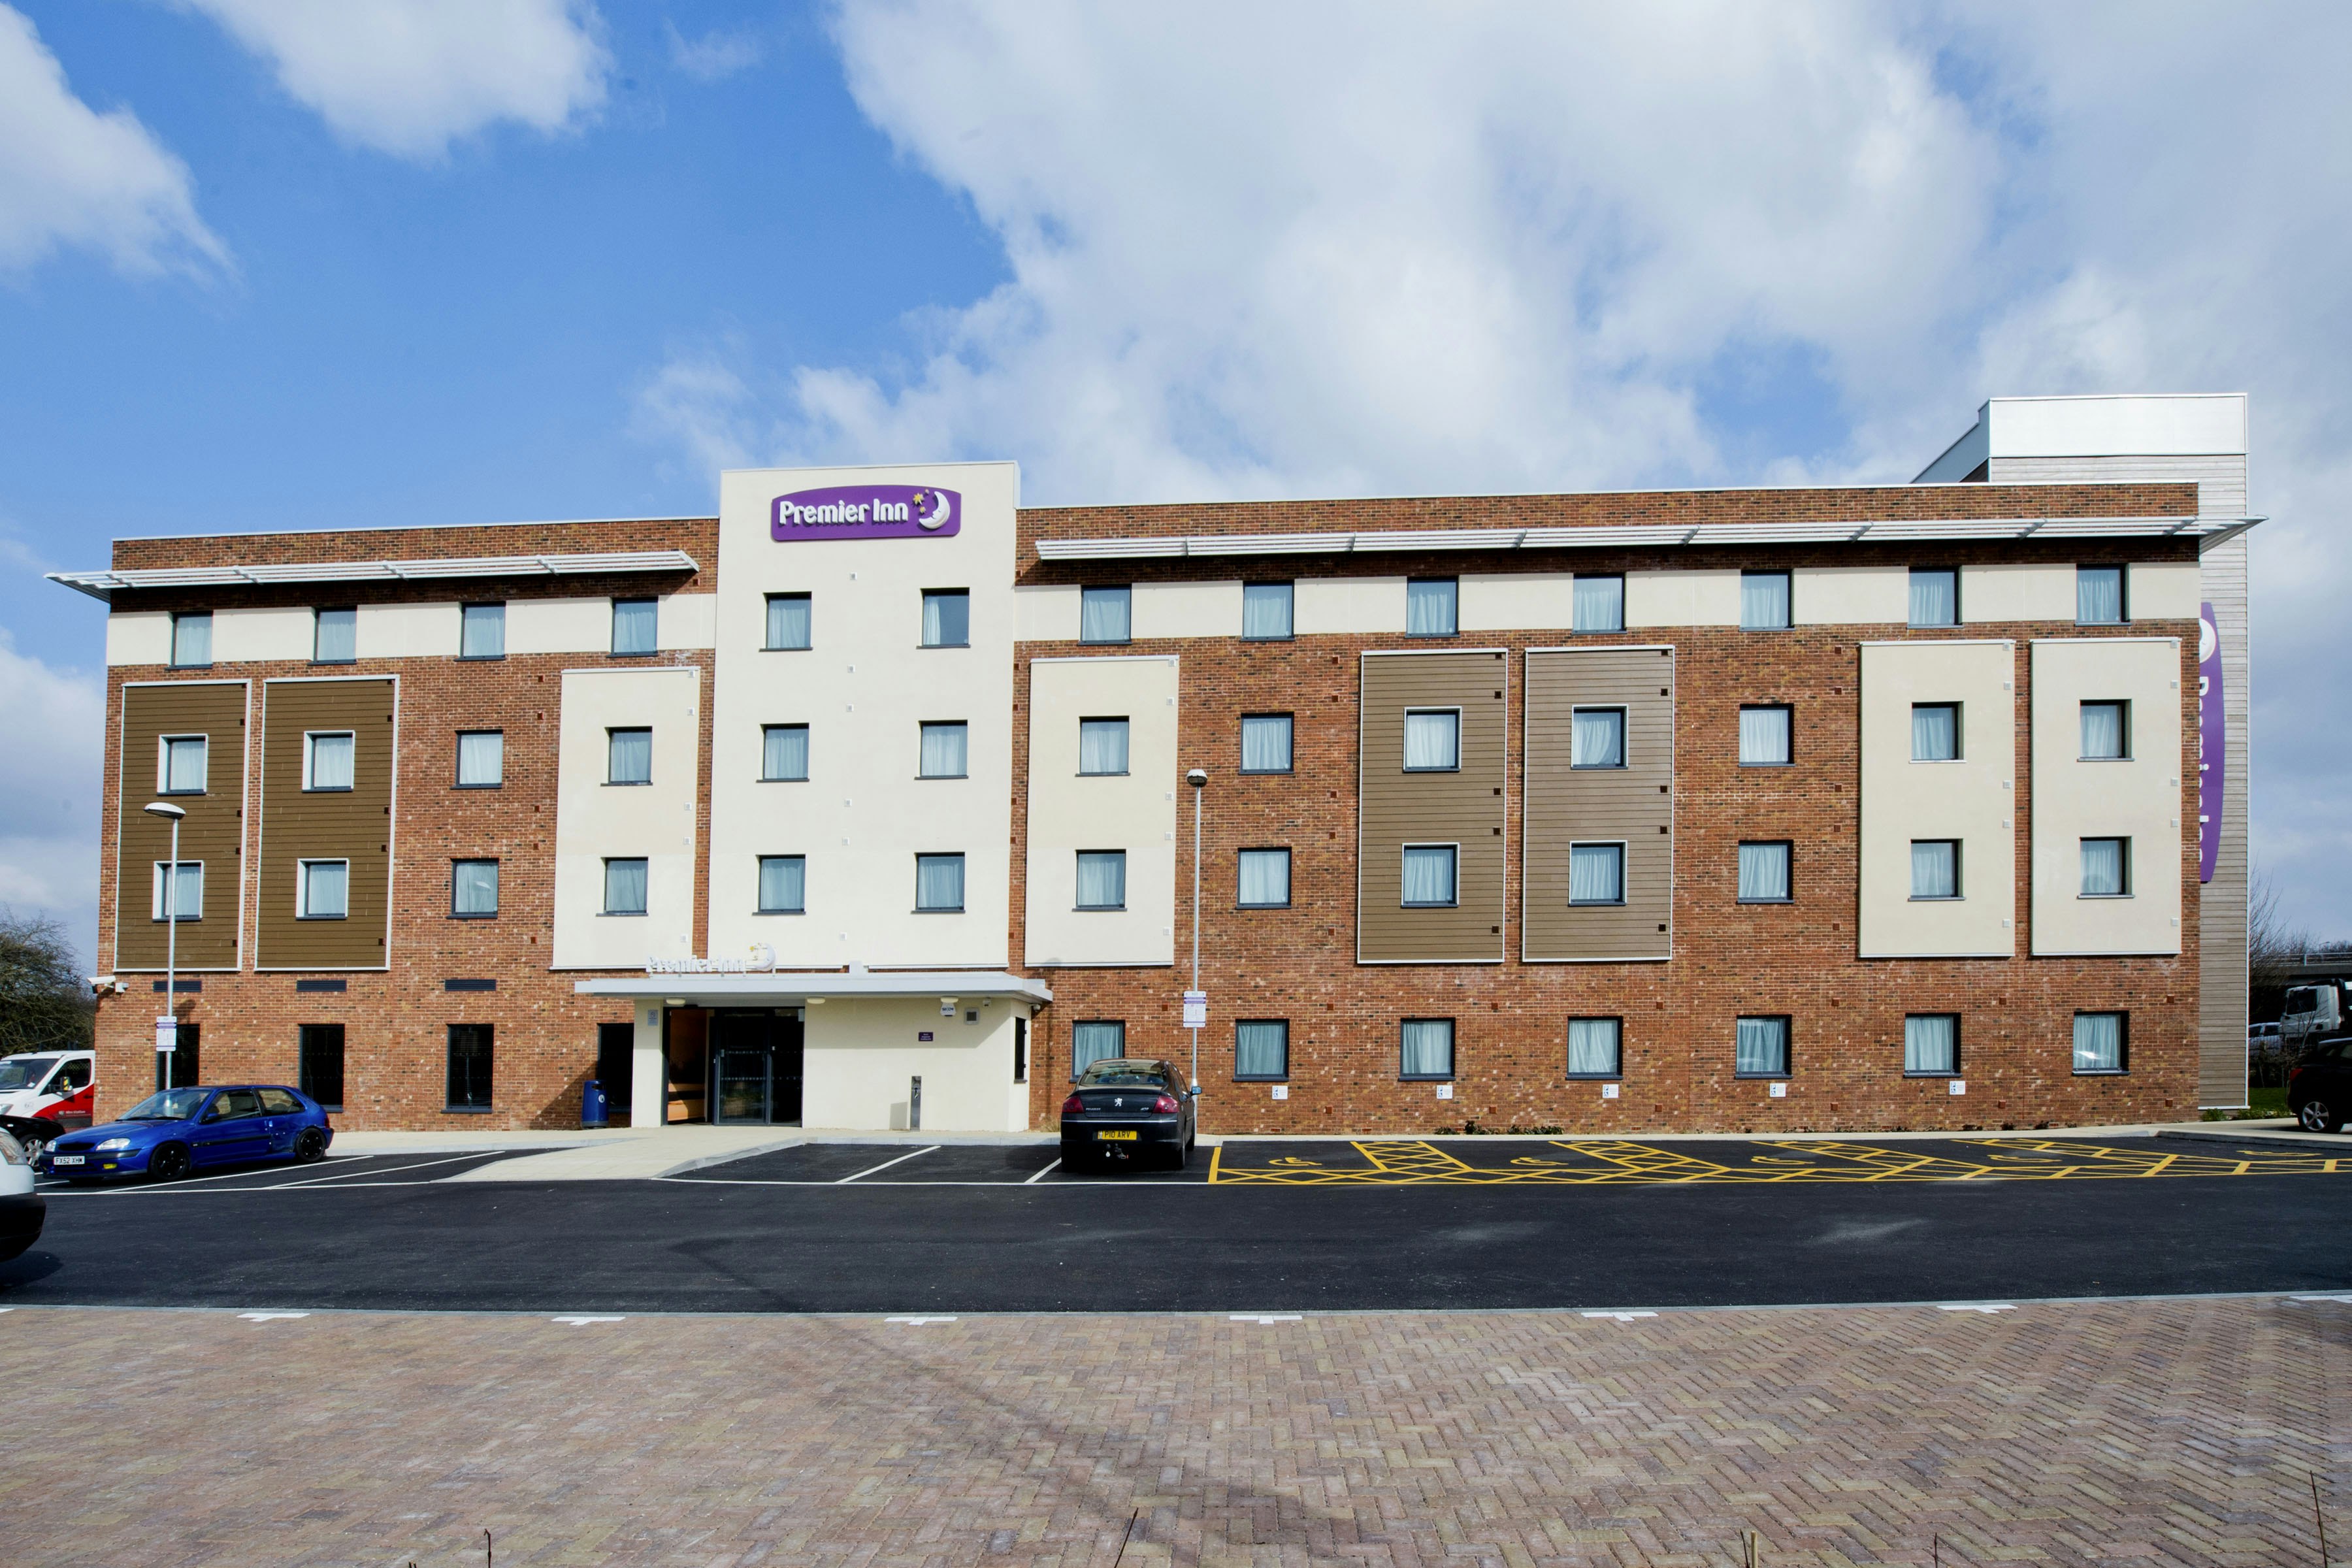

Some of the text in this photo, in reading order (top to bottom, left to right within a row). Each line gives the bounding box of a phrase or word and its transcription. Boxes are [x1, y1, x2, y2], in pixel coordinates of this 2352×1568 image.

[779, 498, 909, 525] Premier Inn
[646, 955, 746, 972] Premier Inn
